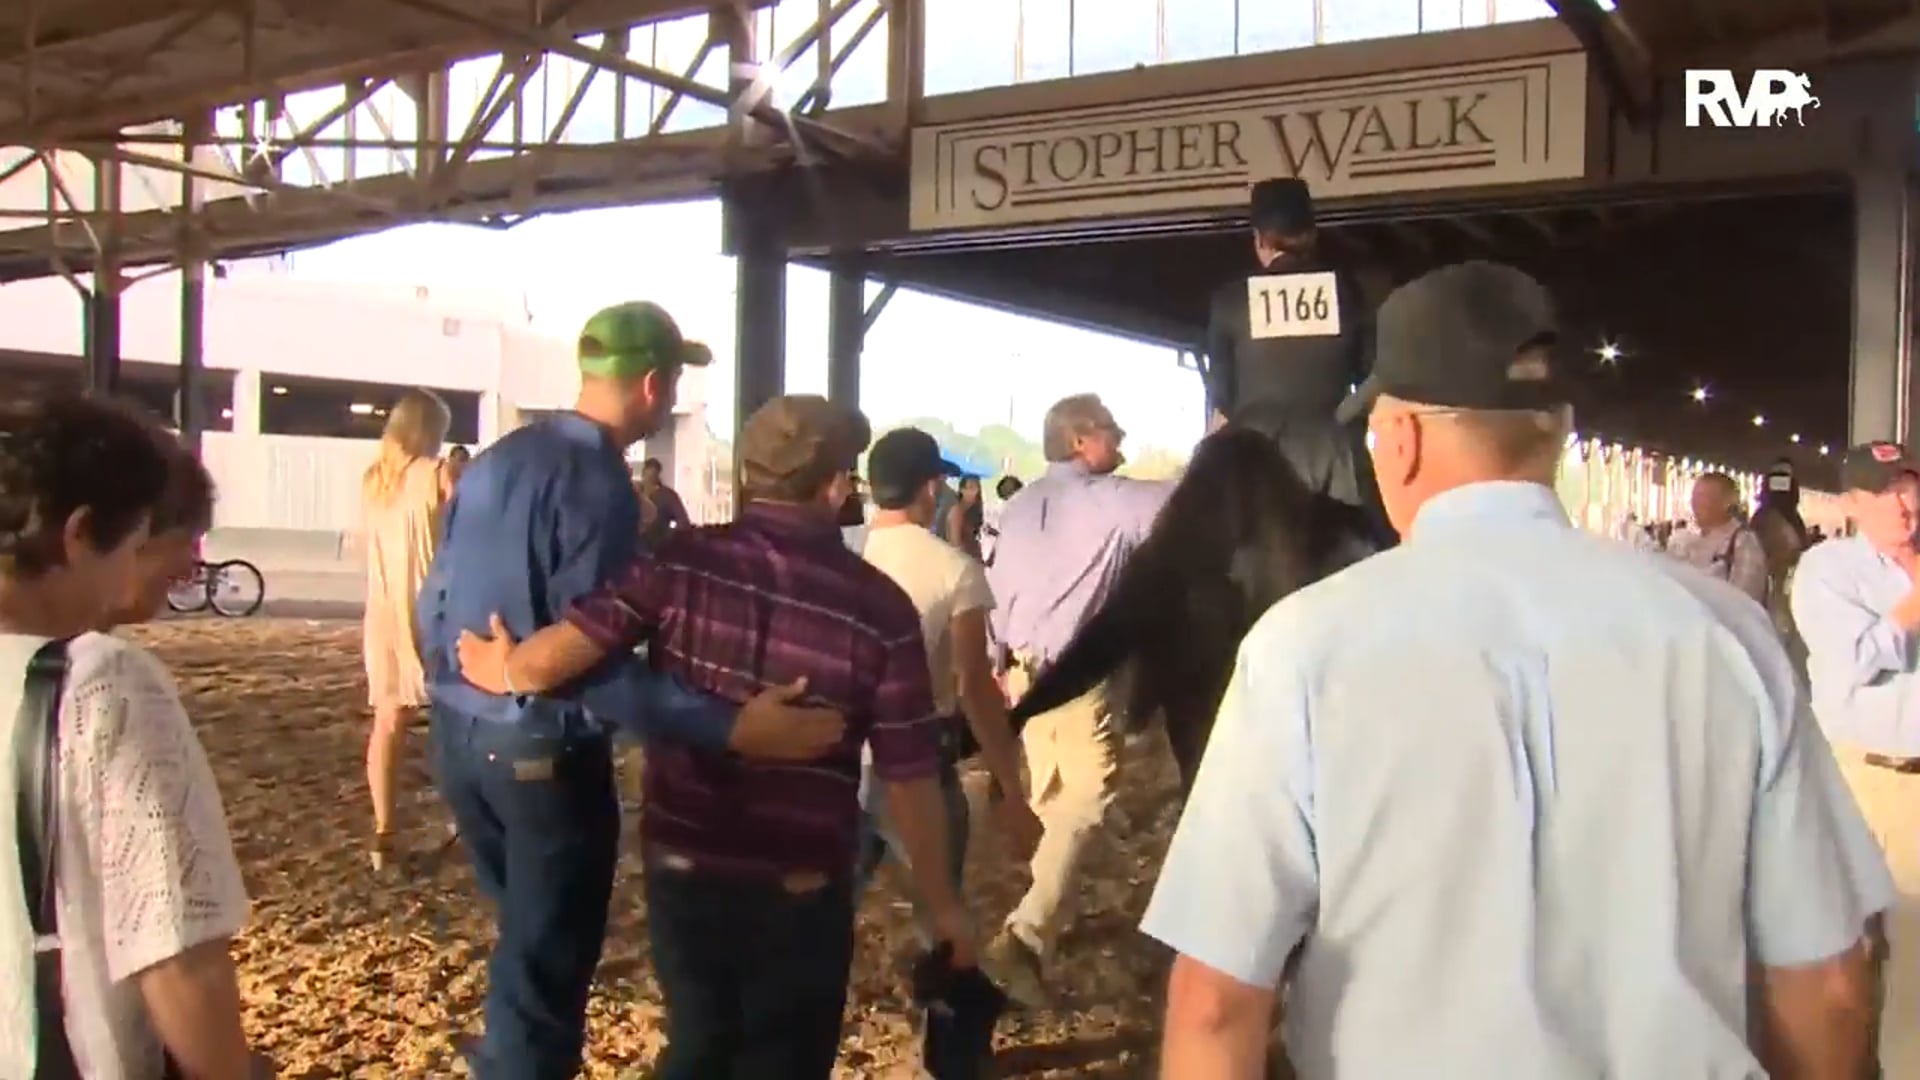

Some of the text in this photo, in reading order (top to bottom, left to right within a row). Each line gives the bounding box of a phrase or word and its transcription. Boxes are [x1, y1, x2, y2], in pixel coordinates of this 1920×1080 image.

[971, 94, 1494, 211] STOPHER WALK
[1259, 285, 1330, 326] 1166
